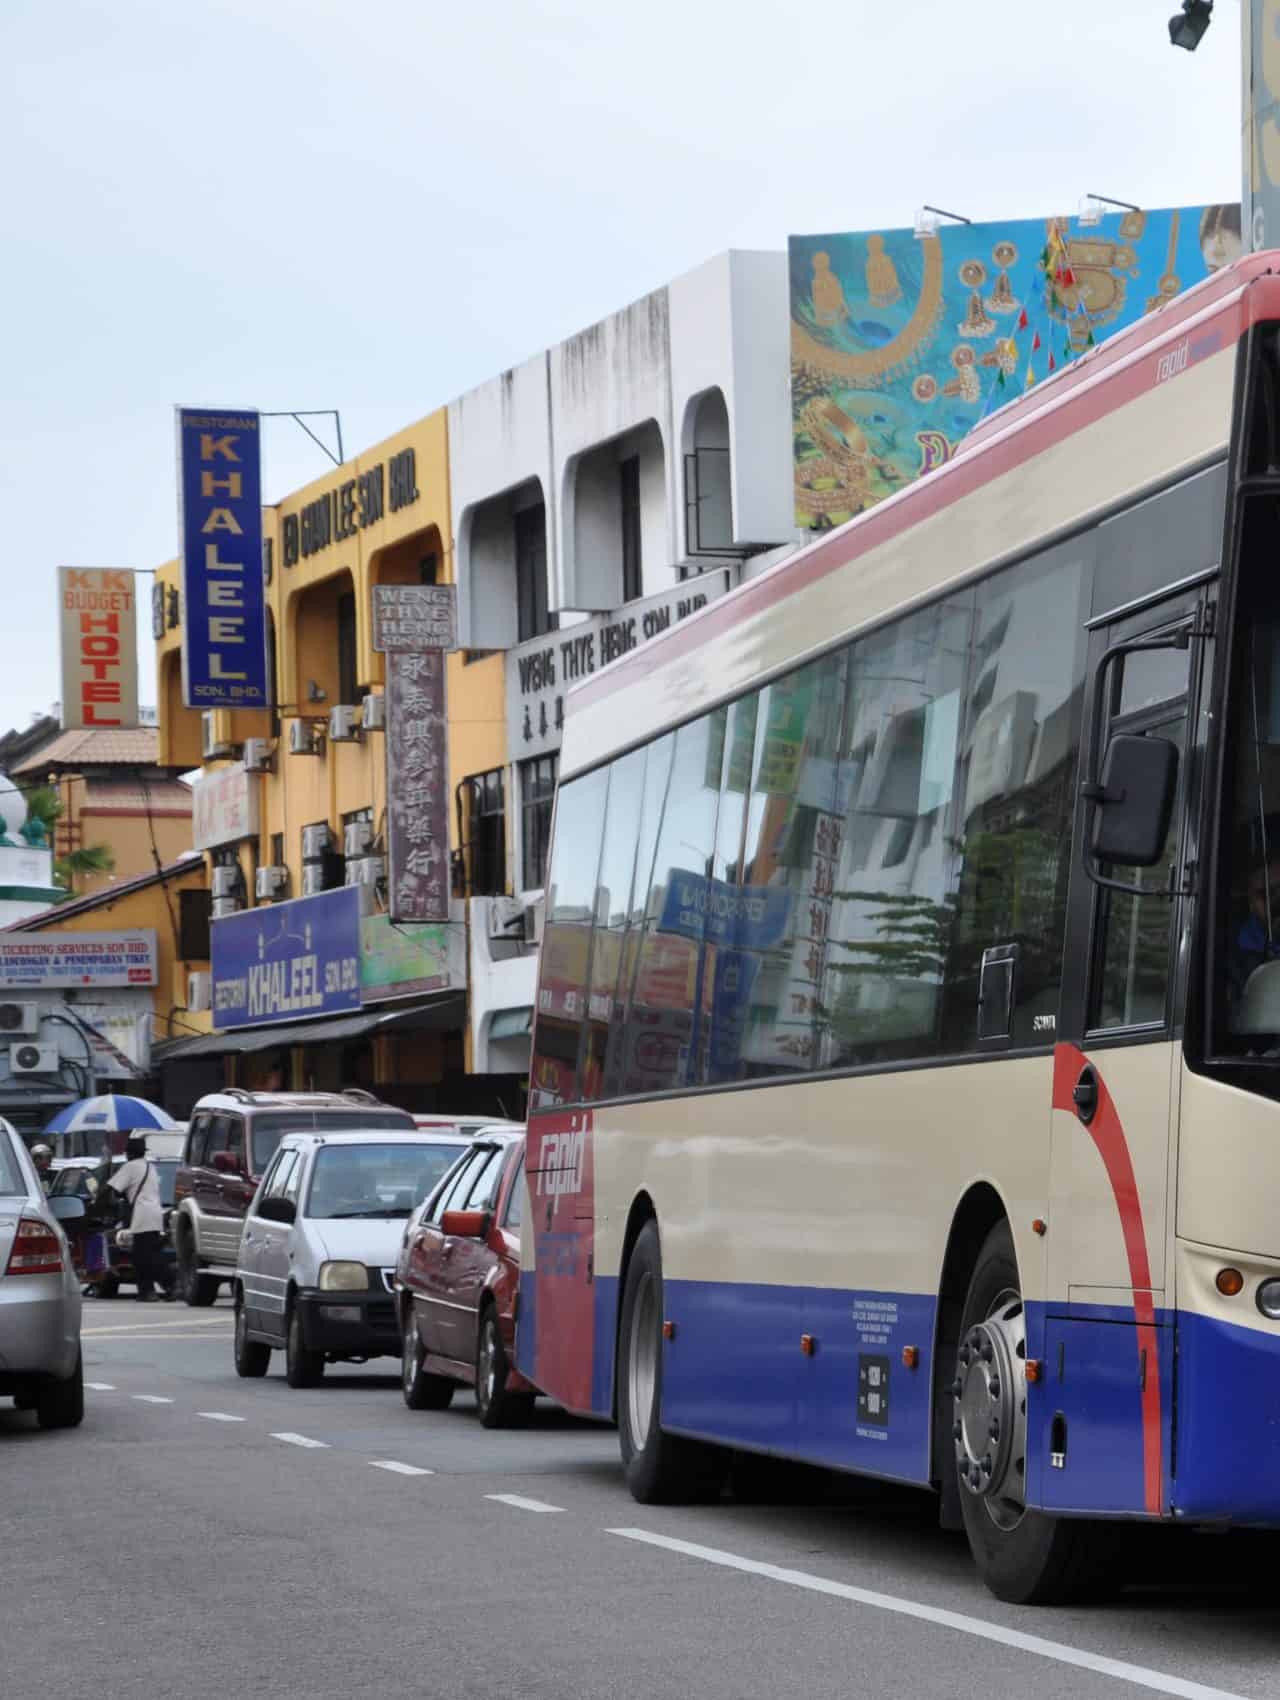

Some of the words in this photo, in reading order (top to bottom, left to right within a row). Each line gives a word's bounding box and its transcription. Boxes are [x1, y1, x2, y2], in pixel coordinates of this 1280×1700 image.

[332, 479, 358, 542] LEE
[200, 434, 246, 680] KHALEEL
[65, 591, 131, 610] BUDGET
[380, 590, 450, 605] WENG
[80, 612, 121, 726] HOTEL
[518, 647, 556, 695] WENG
[560, 632, 595, 681] THYE
[600, 618, 637, 666] HENG
[247, 954, 324, 1017] KHALEEL
[536, 1115, 587, 1214] rapid
